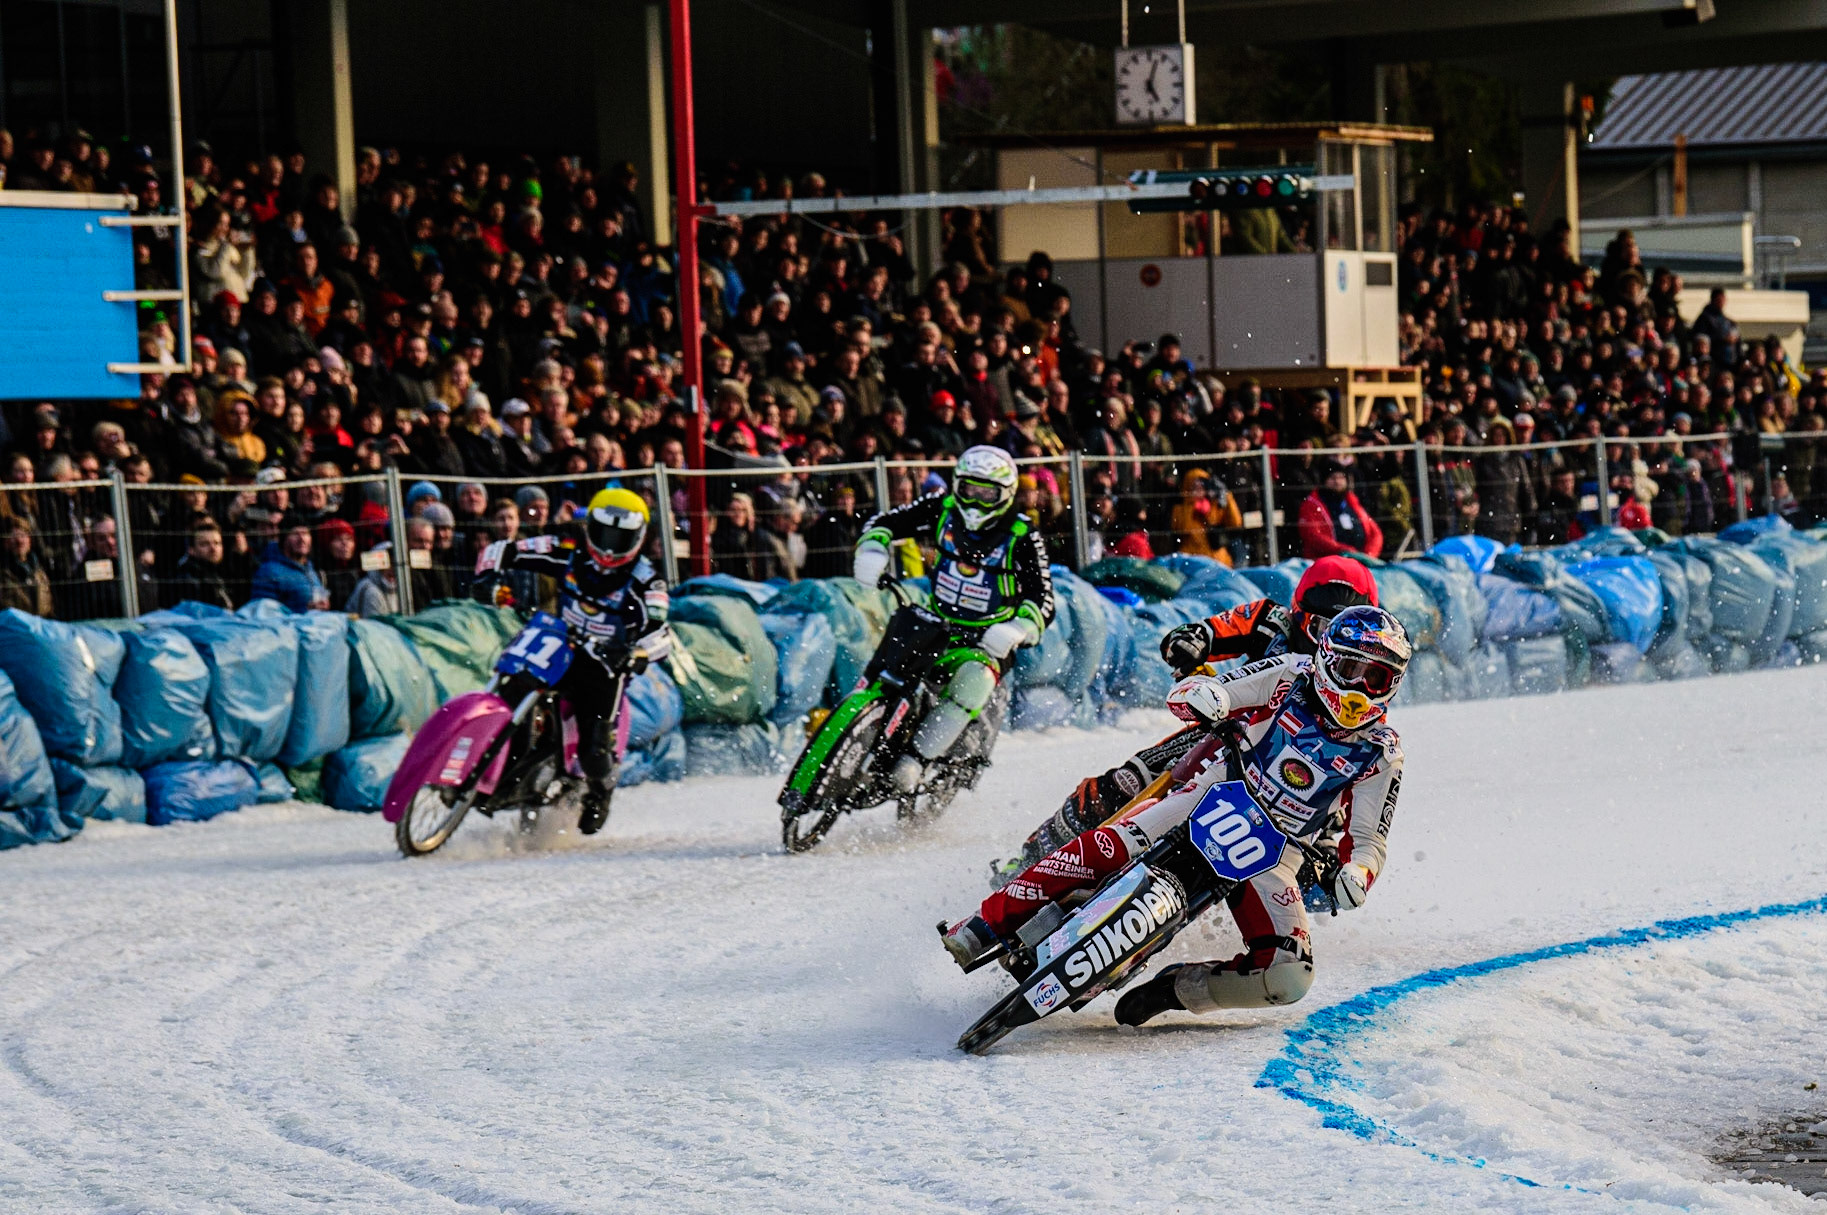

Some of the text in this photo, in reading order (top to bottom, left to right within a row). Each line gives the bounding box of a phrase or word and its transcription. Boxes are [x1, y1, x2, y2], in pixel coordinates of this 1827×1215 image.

[1122, 771, 1139, 790] JAWA
[1196, 798, 1267, 870] 100
[1033, 983, 1061, 1008] FUCHS
